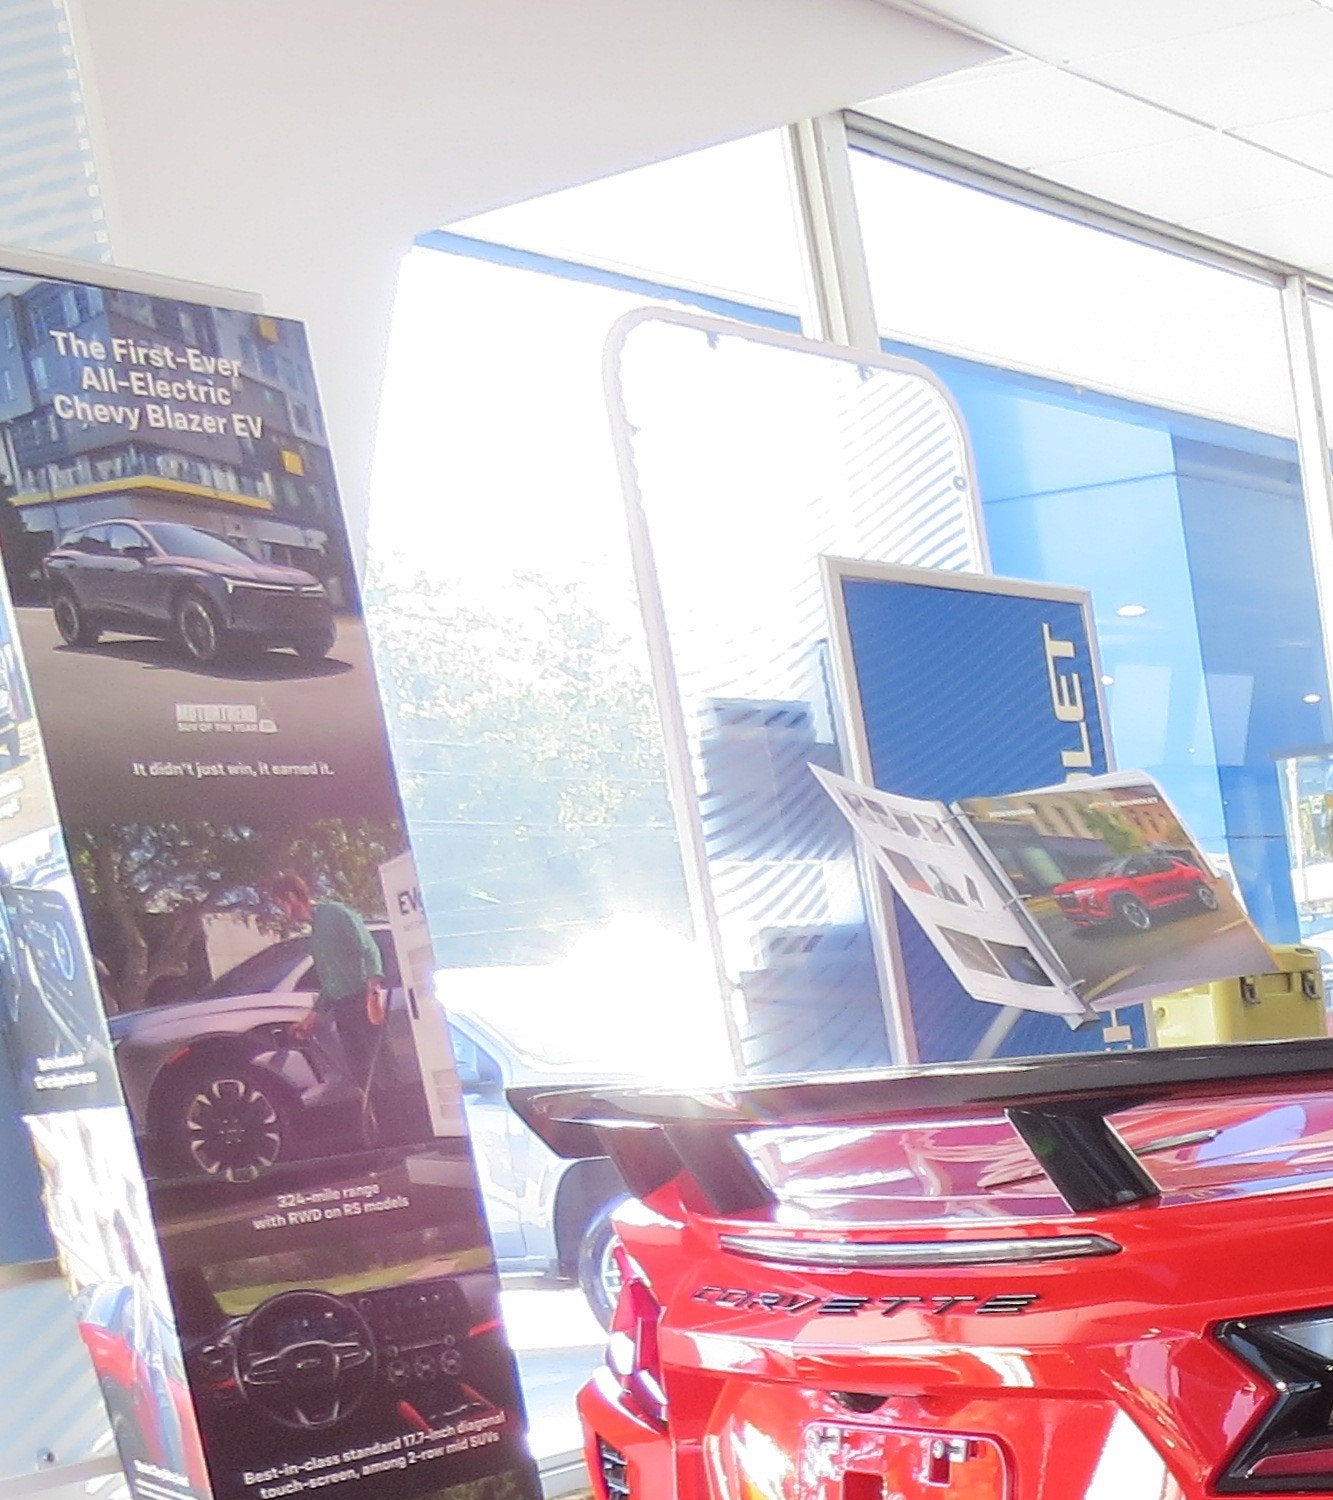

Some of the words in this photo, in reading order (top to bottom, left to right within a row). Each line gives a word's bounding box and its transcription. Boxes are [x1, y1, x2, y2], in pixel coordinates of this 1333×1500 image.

[50, 330, 107, 361] The
[111, 338, 242, 378] First-Ever
[82, 366, 232, 406] All-Electric
[54, 394, 140, 431] Chevy
[146, 404, 227, 435] Blazer
[231, 413, 264, 439] EV
[1042, 622, 1093, 784] LET
[133, 762, 148, 777] It
[150, 761, 195, 776] didn't
[196, 762, 226, 779] just
[227, 762, 257, 777] win,
[258, 761, 271, 775] it
[272, 761, 317, 775] earned
[320, 761, 335, 775] it.
[252, 1214, 286, 1230] with
[287, 1208, 323, 1225] RWD
[324, 1207, 342, 1219] on
[343, 1202, 362, 1216] RS
[363, 1196, 410, 1213] models
[277, 1188, 341, 1208] 324-mile
[343, 1184, 381, 1198] range
[693, 1285, 1041, 1318] CORVETTE
[243, 1453, 340, 1485] Best-in-class
[343, 1436, 401, 1463] standard
[403, 1425, 455, 1448] 17.7-inch
[457, 1411, 506, 1435] diagonal
[260, 1467, 361, 1500] touch-screen,
[362, 1455, 407, 1476] among
[407, 1446, 444, 1464] 2-row
[446, 1438, 468, 1455] mid
[470, 1430, 500, 1448] SUVs
